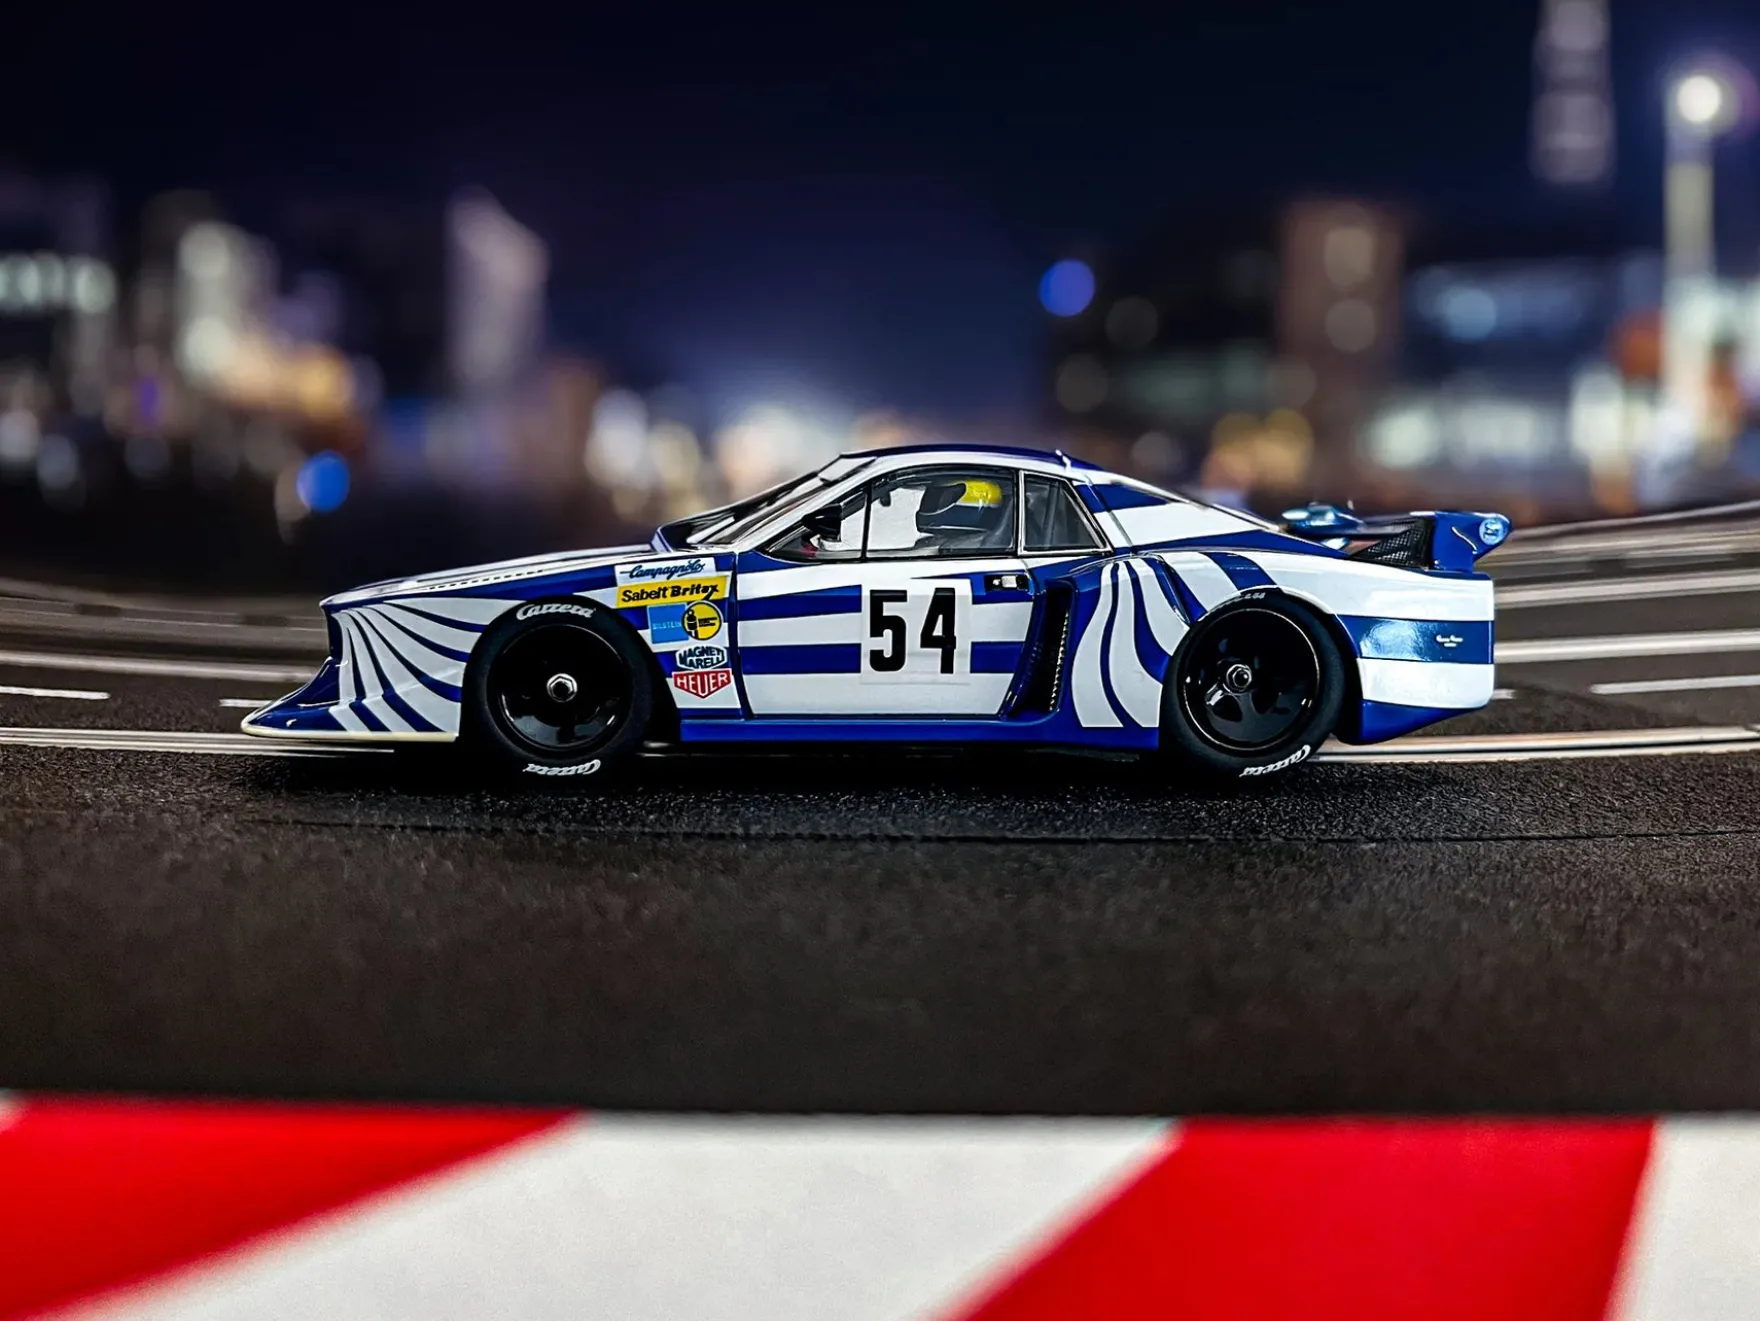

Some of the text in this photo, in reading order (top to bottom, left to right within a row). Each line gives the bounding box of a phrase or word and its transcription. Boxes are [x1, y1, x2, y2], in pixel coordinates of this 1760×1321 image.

[620, 559, 706, 580] Campagnolo
[670, 584, 719, 601] Britax
[516, 603, 597, 620] Carrera
[869, 587, 957, 674] 54
[677, 672, 728, 697] HEUER
[522, 759, 601, 776] Carrera
[1239, 744, 1311, 778] Carrera
